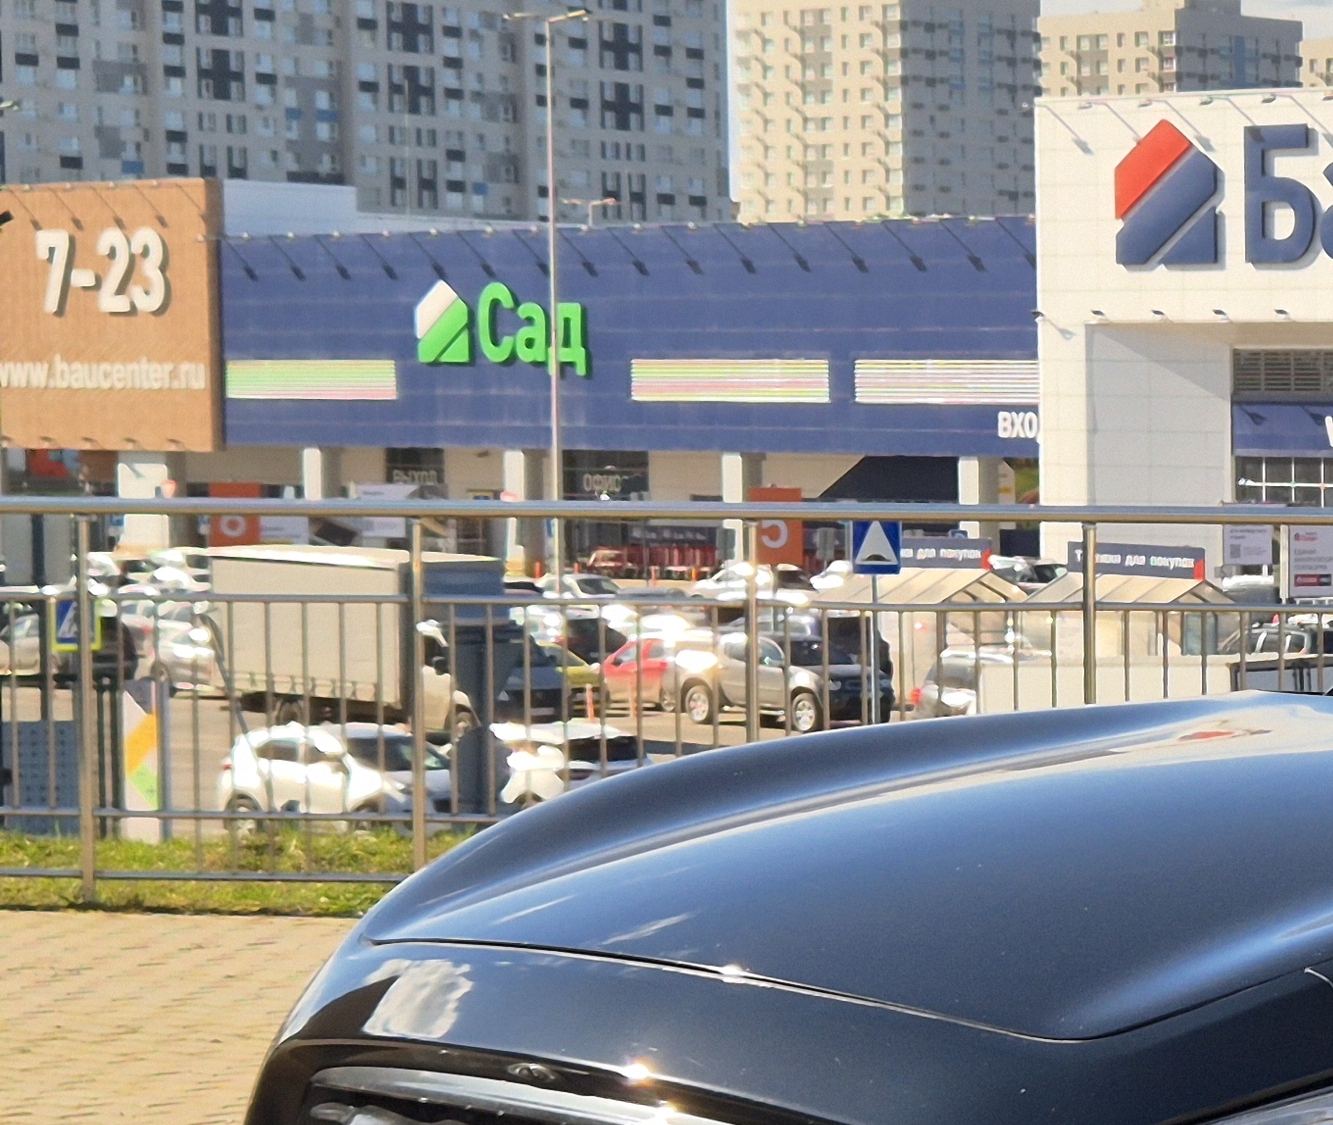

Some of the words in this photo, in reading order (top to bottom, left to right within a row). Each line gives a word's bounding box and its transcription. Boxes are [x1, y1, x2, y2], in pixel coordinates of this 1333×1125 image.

[36, 227, 166, 313] 7-23
[477, 281, 587, 377] Сад
[997, 411, 1041, 443] ВХО
